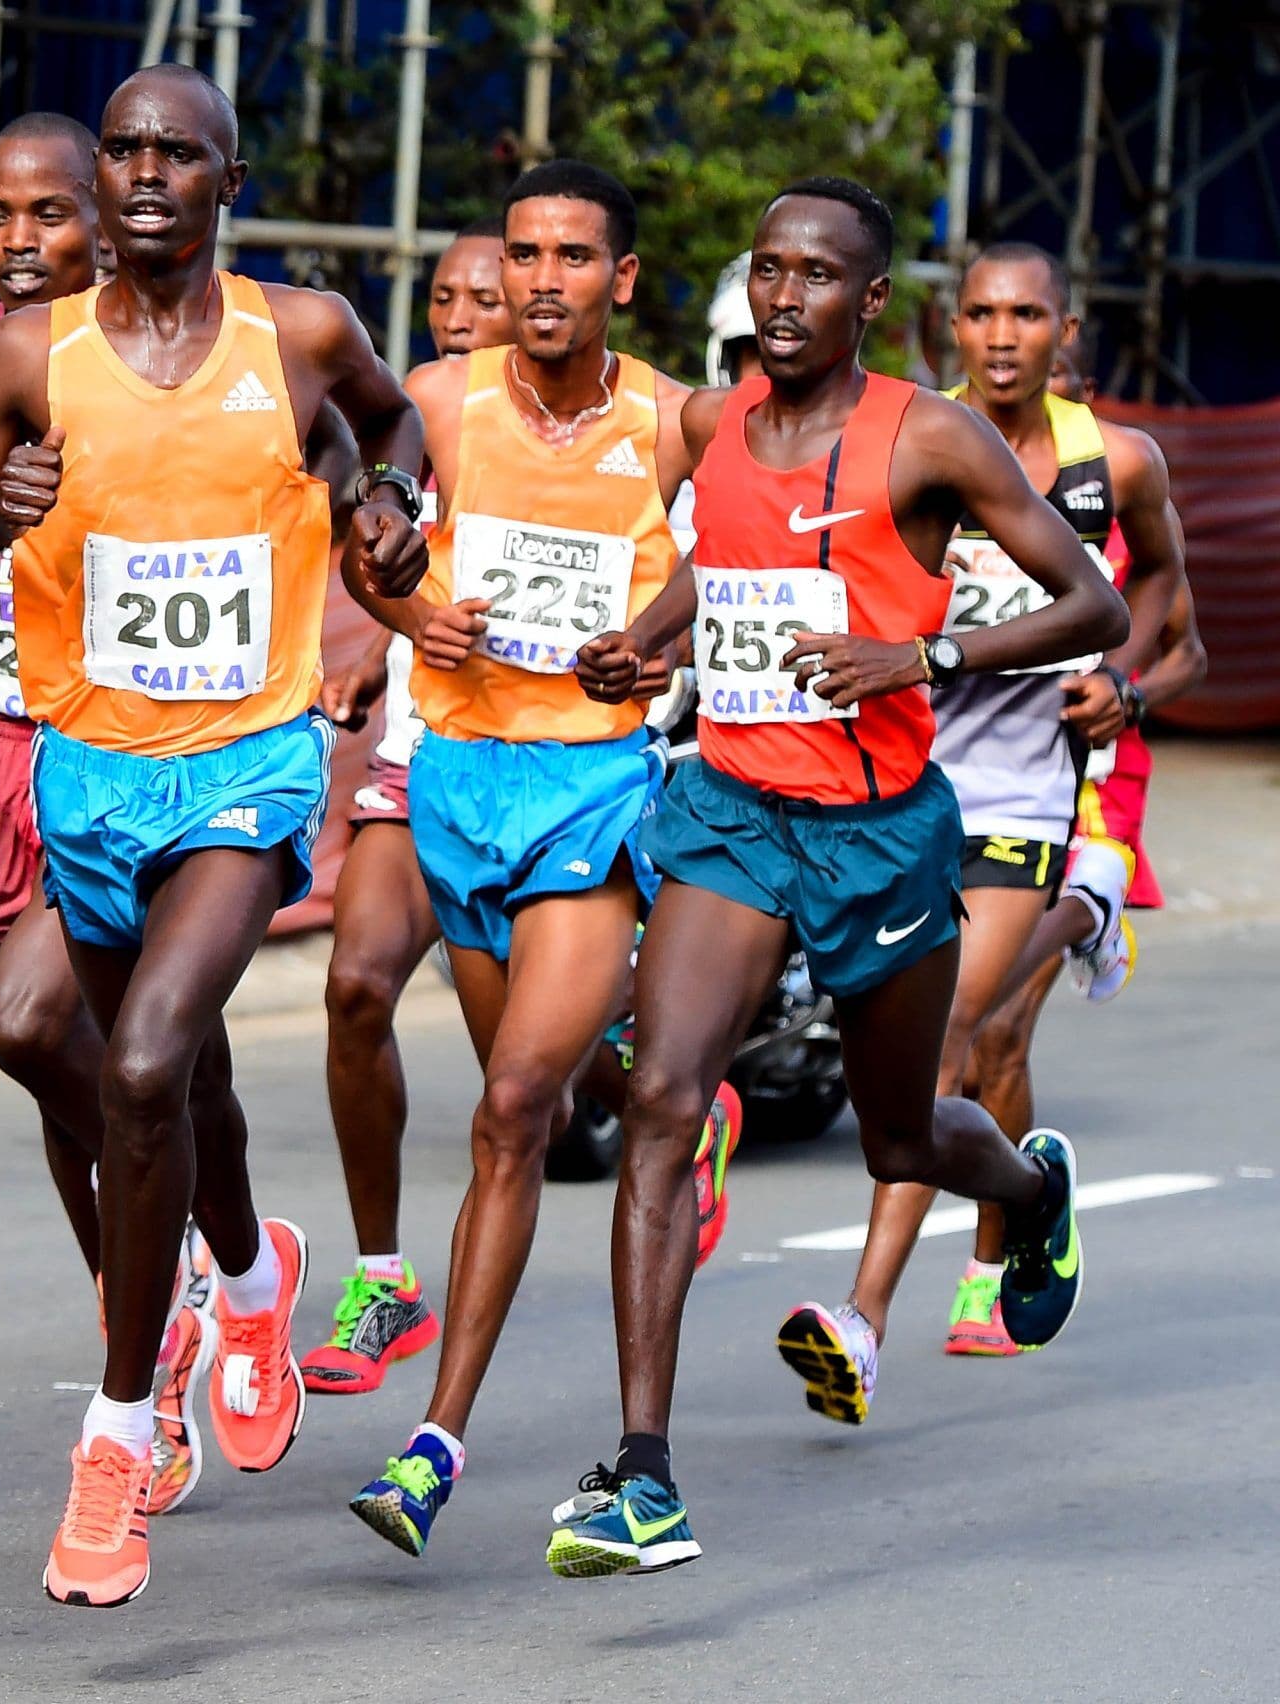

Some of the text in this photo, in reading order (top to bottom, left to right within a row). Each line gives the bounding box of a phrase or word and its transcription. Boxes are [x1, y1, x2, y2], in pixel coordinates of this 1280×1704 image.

[220, 398, 277, 413] adidas
[127, 549, 243, 580] CAIXA
[505, 531, 597, 571] Rexona
[481, 568, 612, 633] 225
[705, 579, 796, 606] CAIXA
[953, 584, 1049, 626] 24
[116, 588, 251, 649] 201
[486, 636, 580, 669] CAIX
[131, 664, 245, 691] CAIXA
[712, 689, 810, 714] CAIXA
